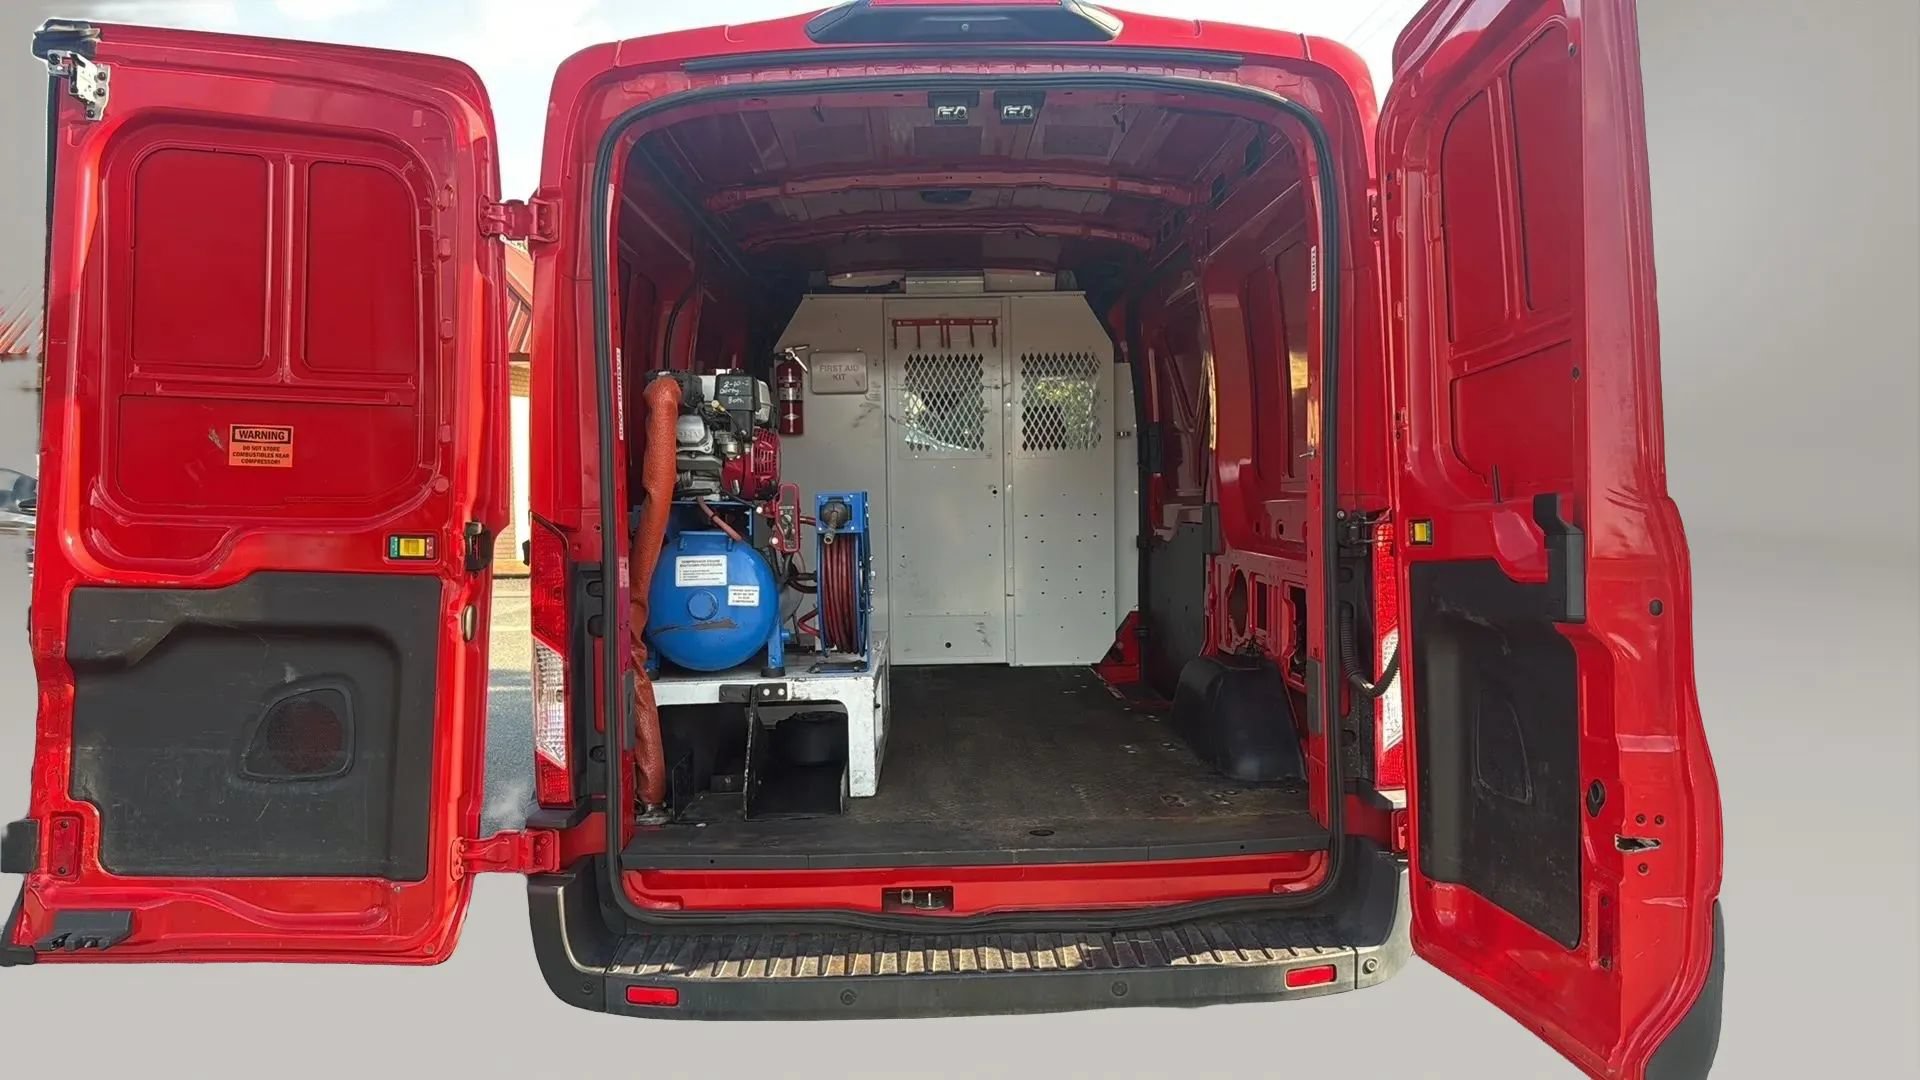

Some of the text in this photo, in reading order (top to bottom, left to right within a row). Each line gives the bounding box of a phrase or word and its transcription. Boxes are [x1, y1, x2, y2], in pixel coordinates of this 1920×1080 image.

[820, 363, 858, 372] FIRST AID
[832, 373, 847, 381] KIT
[239, 430, 286, 441] WARNING
[232, 451, 274, 459] COMBUSTIBLES
